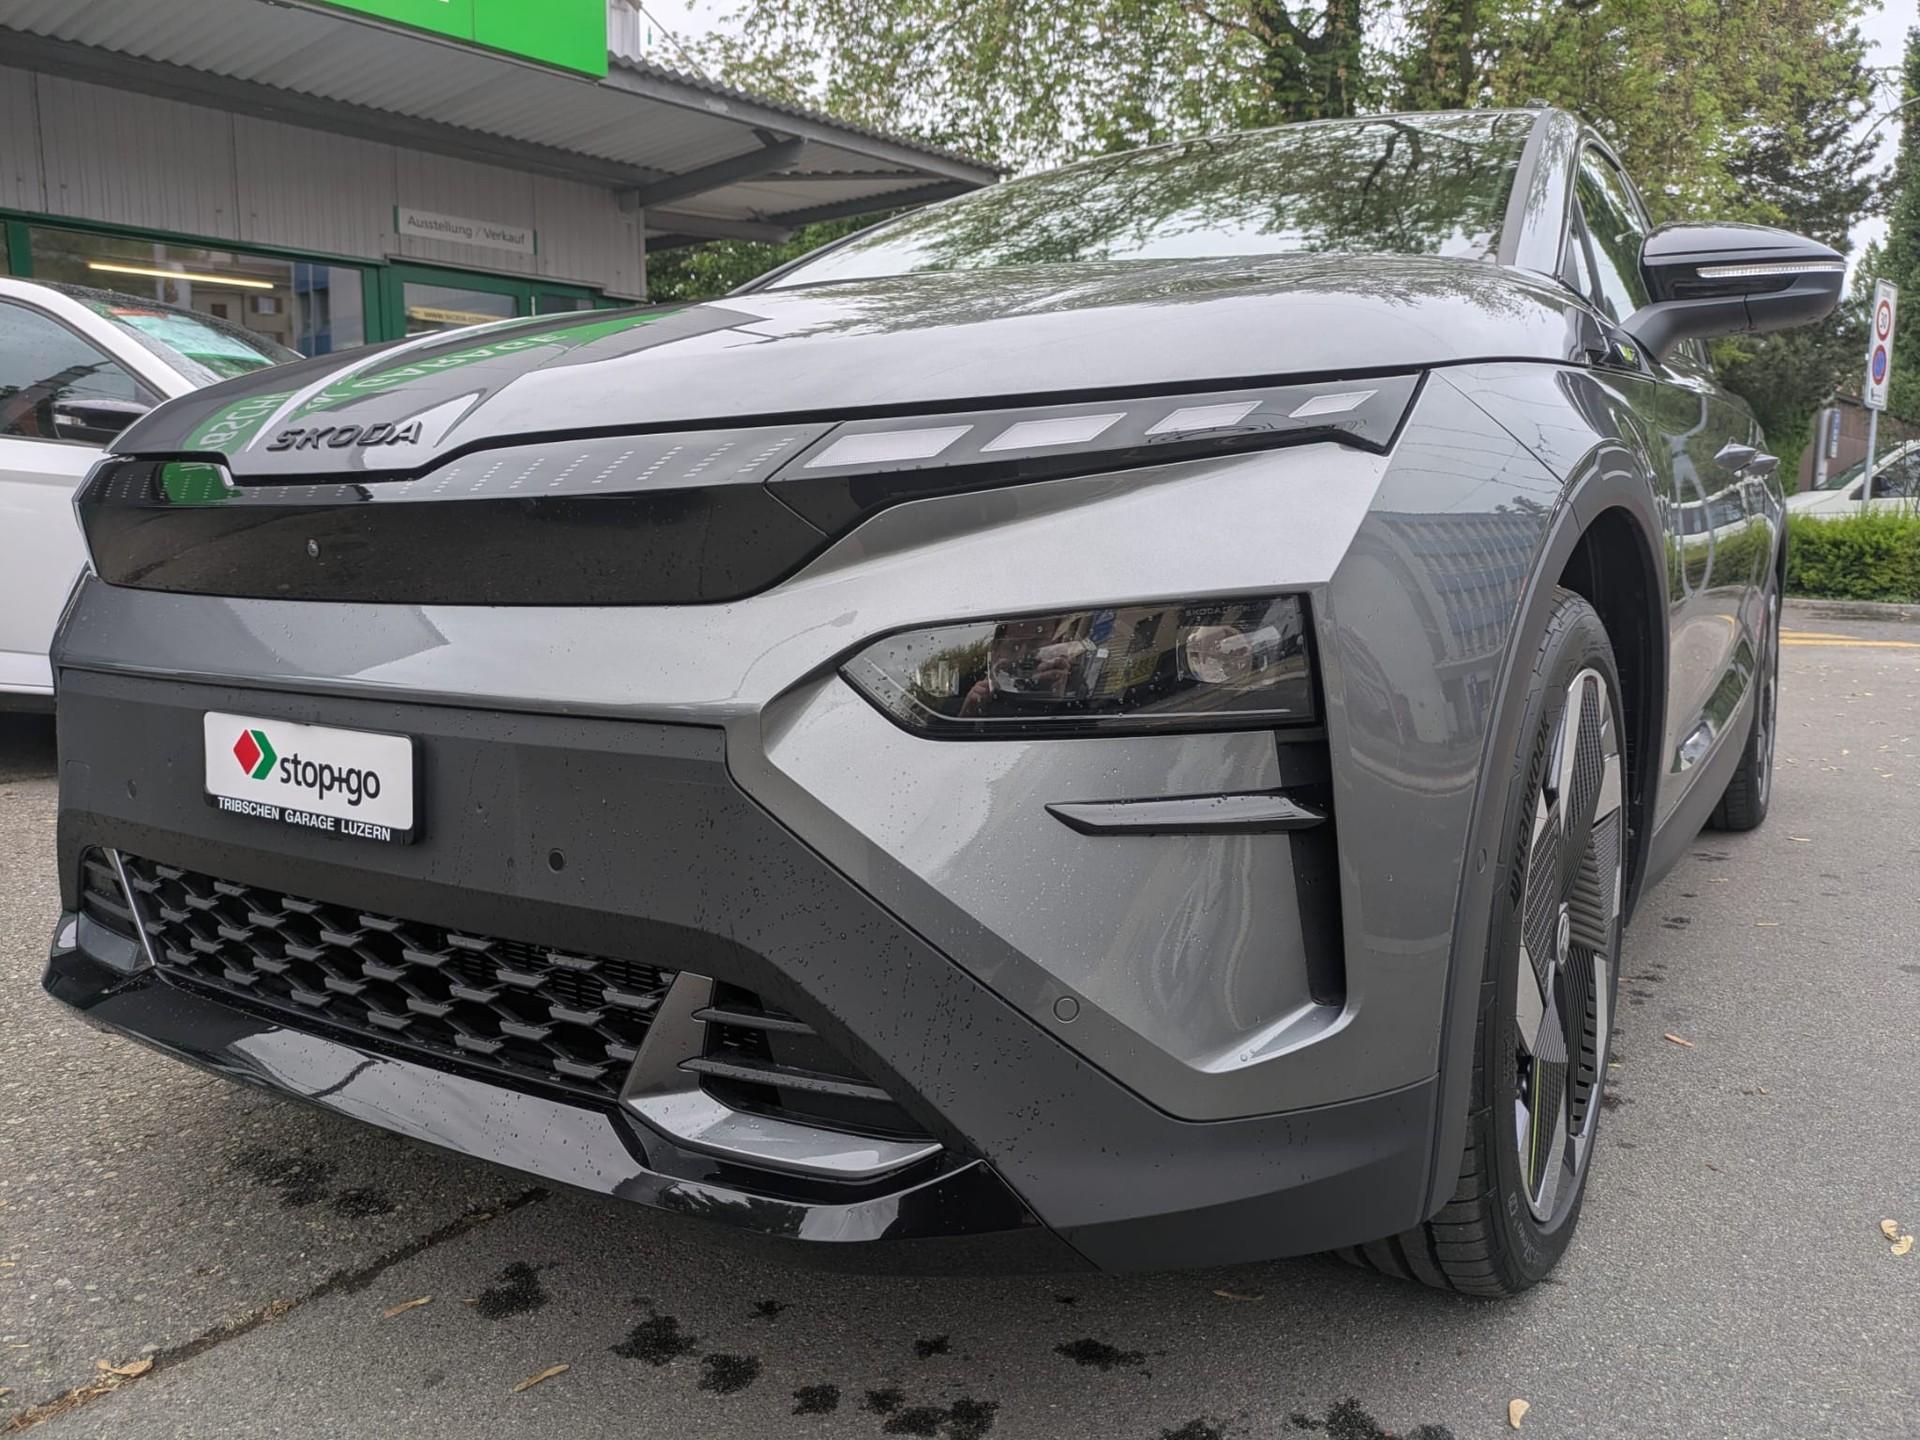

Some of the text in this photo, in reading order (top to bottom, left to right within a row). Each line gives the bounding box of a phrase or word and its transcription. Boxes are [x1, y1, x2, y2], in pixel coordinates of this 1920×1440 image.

[407, 215, 473, 238] Ausstellung
[483, 228, 525, 244] Verkauf
[280, 753, 380, 806] stop+go
[217, 796, 391, 842] TRIBSCHEN GARAGE LUZERN
